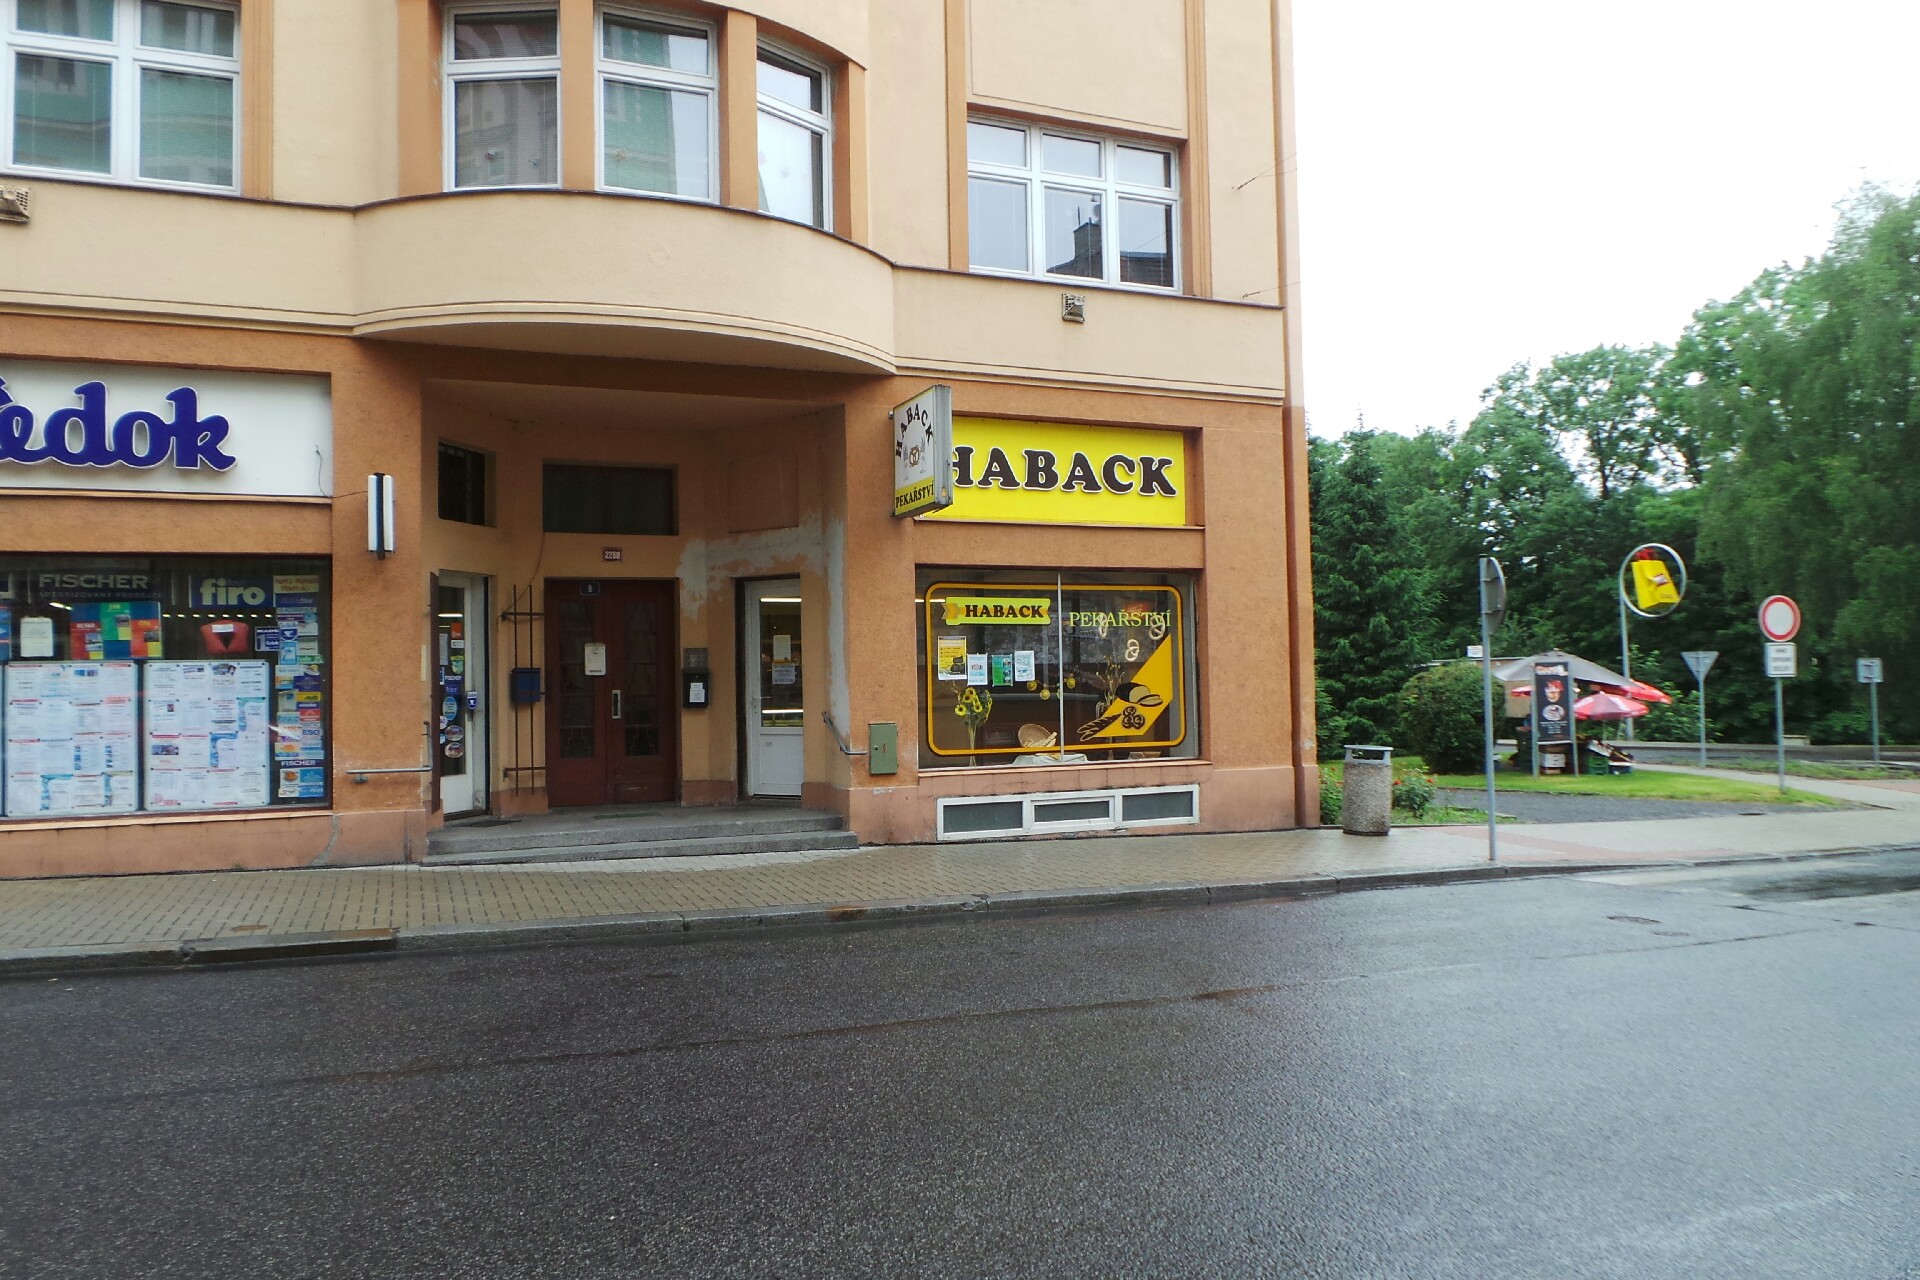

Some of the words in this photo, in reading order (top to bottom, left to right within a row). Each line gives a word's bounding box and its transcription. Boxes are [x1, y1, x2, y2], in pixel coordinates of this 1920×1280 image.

[0, 376, 237, 472] edok
[896, 403, 933, 459] HABACK
[952, 446, 1177, 497] HABACK
[895, 480, 934, 508] PEKAŘSTVÍ
[39, 574, 148, 589] FISCHER
[200, 578, 266, 606] firo
[964, 604, 1044, 618] HABACK
[1069, 609, 1171, 627] PEKAŘSTVÍ
